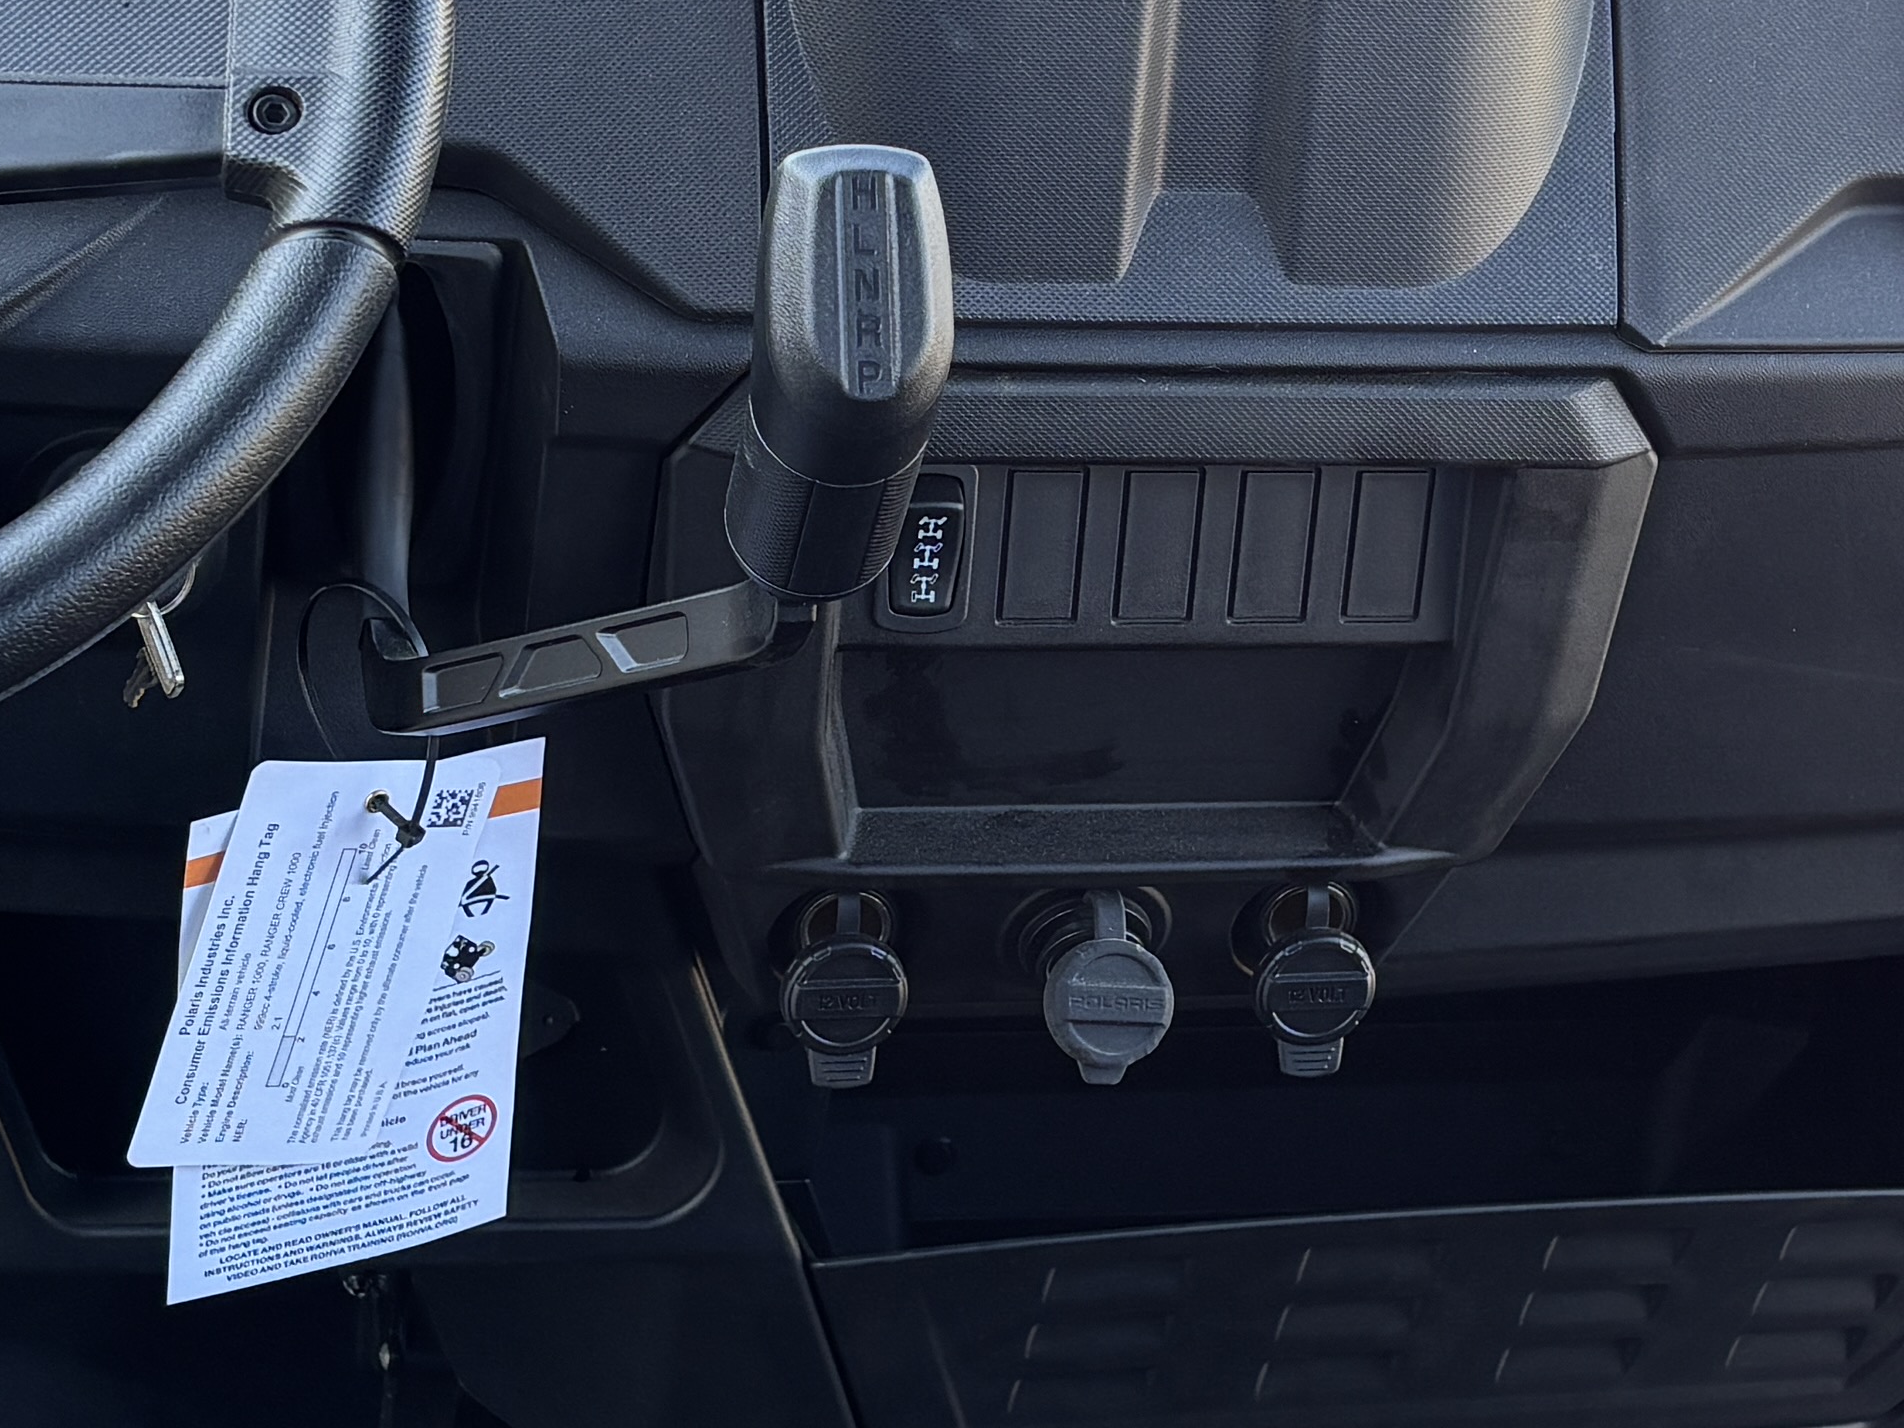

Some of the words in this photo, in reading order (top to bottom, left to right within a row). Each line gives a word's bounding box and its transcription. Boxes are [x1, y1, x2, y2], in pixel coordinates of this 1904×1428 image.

[851, 177, 878, 210] H
[853, 224, 878, 255] L
[855, 269, 881, 302] N
[856, 315, 883, 348] R
[858, 360, 882, 394] P
[258, 824, 280, 848] Tag
[247, 852, 270, 886] Hang
[287, 852, 302, 874] 1000
[299, 851, 319, 896] electronic
[312, 831, 326, 849] fuel
[276, 878, 293, 910] CREW
[222, 891, 255, 965] Information
[260, 913, 282, 957] RANGER
[179, 991, 203, 1035] Polaris
[195, 923, 226, 988] Industries
[217, 896, 235, 919] Inc.
[236, 953, 251, 985] vehicle
[252, 960, 269, 984] 1000,
[198, 970, 229, 1036] Emissions
[236, 988, 258, 1030] RANGER
[1069, 995, 1165, 1012] POLARIS
[415, 1042, 440, 1054] Plan
[442, 1029, 477, 1047] Ahead
[175, 1040, 205, 1104] Consumer
[198, 1110, 217, 1144] Vehicle
[210, 1079, 227, 1107] Model
[221, 1035, 243, 1077] Name(s):
[215, 1110, 234, 1143] Engine
[227, 1052, 253, 1108] Description:
[180, 1110, 199, 1144] Vehicle
[192, 1082, 209, 1108] Type:
[440, 1104, 486, 1127] DRIVER
[440, 1117, 485, 1139] UNDER
[232, 1119, 248, 1142] NER:
[450, 1132, 473, 1152] 16
[204, 1253, 281, 1277] INSTRUCTIONS
[283, 1248, 304, 1258] AND
[365, 1223, 404, 1238] ALWAYS
[406, 1212, 442, 1228] REVIEW
[444, 1200, 478, 1216] SAFETY
[219, 1249, 259, 1264] LOCATE
[261, 1243, 283, 1254] AND
[284, 1236, 312, 1248] READ
[314, 1224, 361, 1241] OWNER'S
[409, 1201, 448, 1218] FOLLOW
[450, 1195, 465, 1205] ALL
[227, 1268, 258, 1281] VIDEO
[260, 1263, 282, 1273] AND
[284, 1256, 308, 1268] TAKE
[310, 1247, 346, 1261] ROHVA
[347, 1235, 394, 1252] TRAINING
